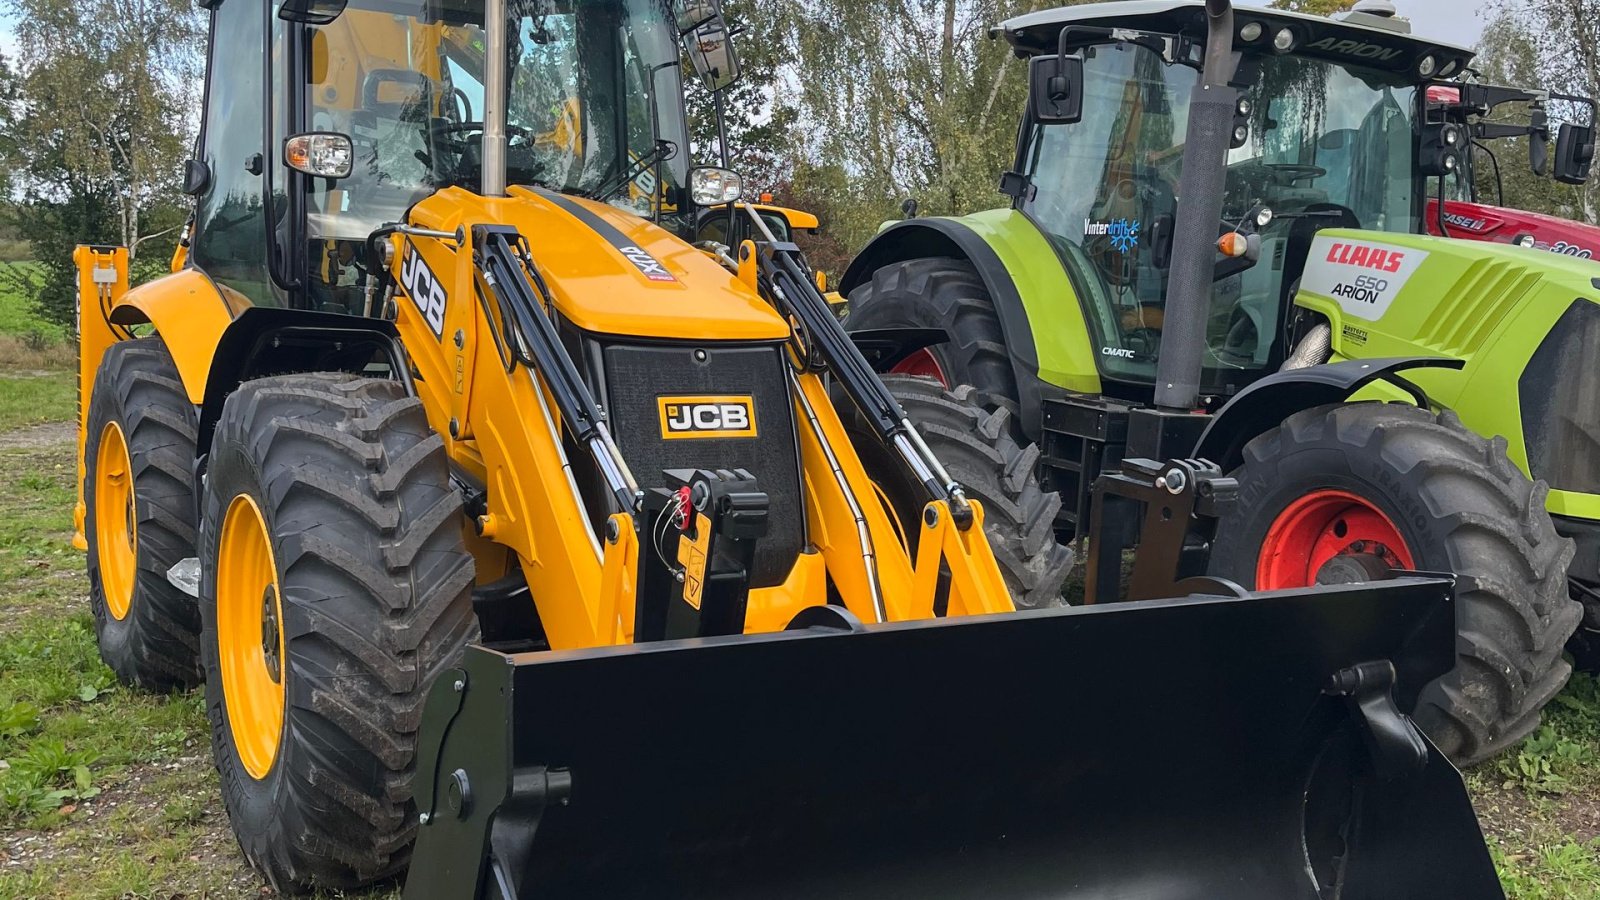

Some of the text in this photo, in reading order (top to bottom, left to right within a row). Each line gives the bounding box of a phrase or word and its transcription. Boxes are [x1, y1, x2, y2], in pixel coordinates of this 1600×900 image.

[1306, 37, 1403, 60] ARION
[1326, 243, 1405, 273] CLAAS
[402, 249, 446, 335] JCB
[1331, 283, 1379, 304] ARION
[1354, 275, 1388, 293] 650
[1102, 346, 1135, 358] CMATIC
[668, 404, 748, 429] JCB
